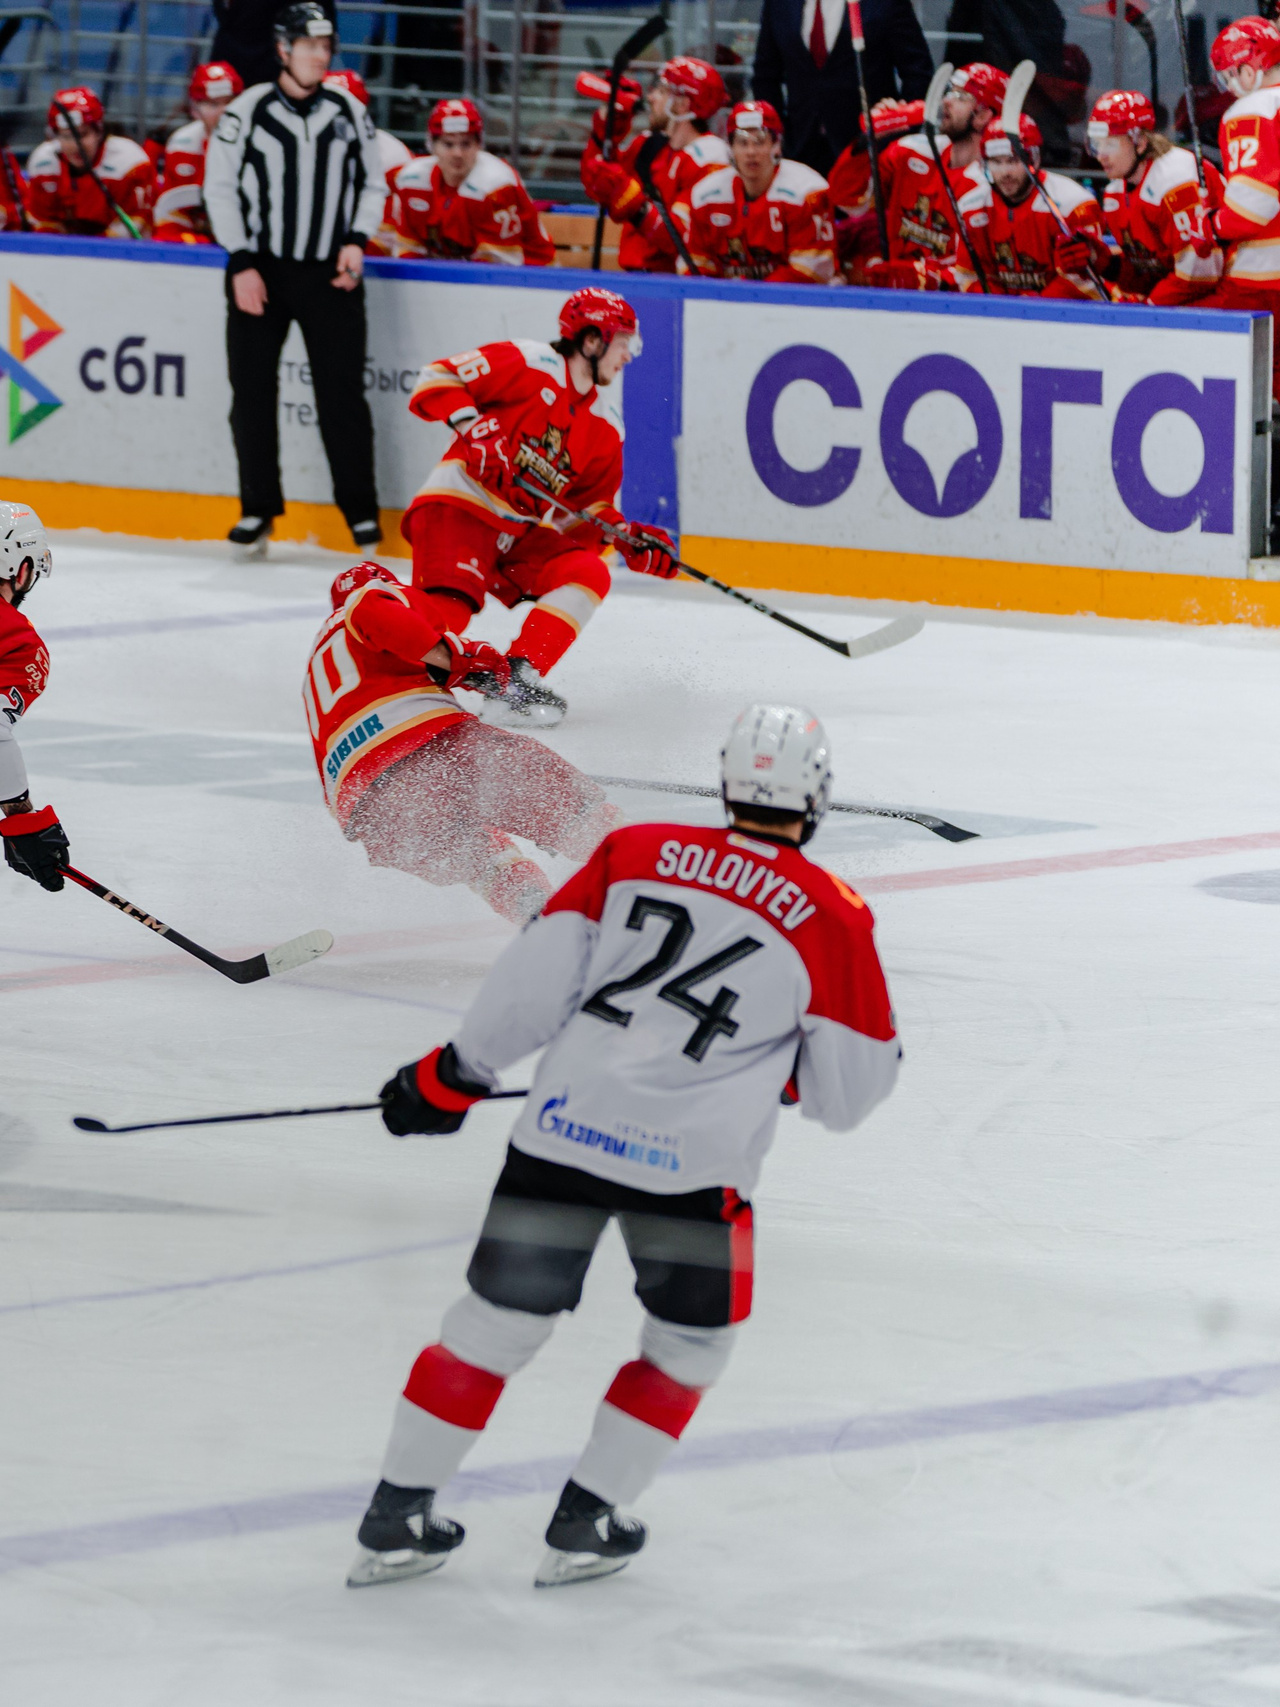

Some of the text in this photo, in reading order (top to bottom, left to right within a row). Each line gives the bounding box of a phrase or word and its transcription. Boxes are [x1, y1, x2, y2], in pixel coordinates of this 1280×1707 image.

[80, 336, 185, 398] сбп
[471, 418, 501, 440] CC
[746, 344, 1237, 535] сога
[327, 713, 385, 783] SIBUR
[102, 890, 171, 935] CCM
[655, 840, 817, 931] SOLOVYEV
[580, 895, 765, 1064] 24
